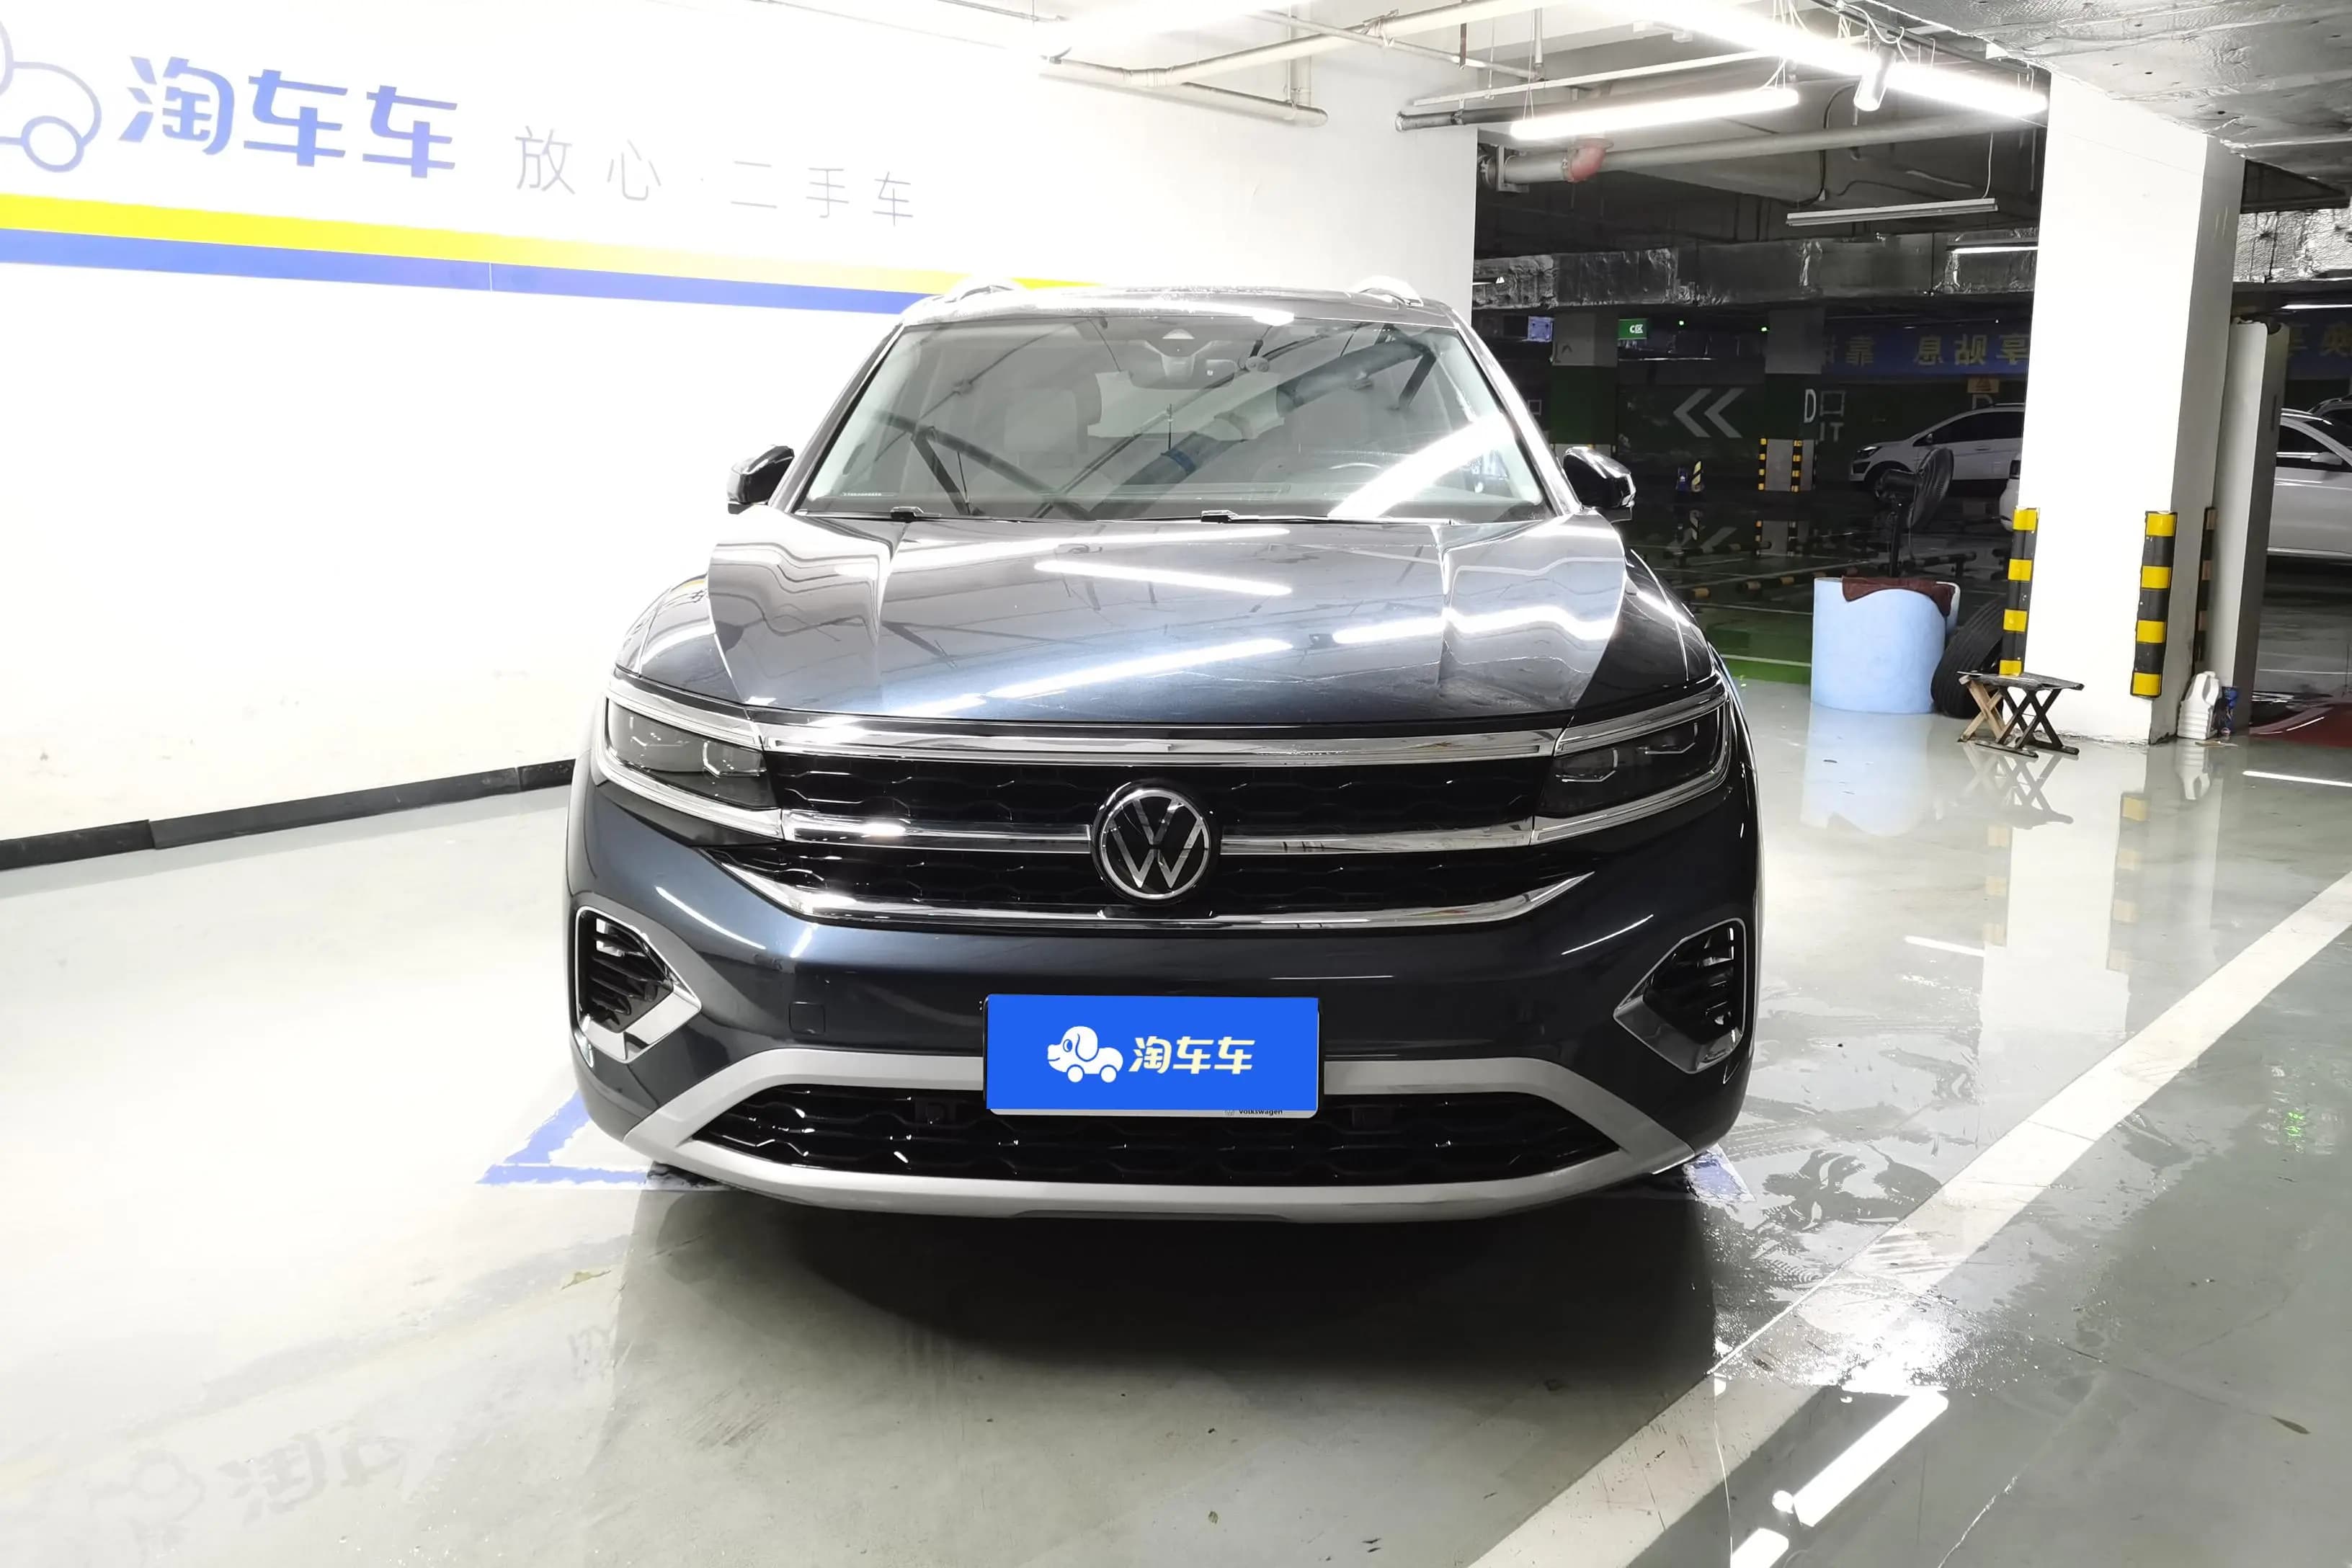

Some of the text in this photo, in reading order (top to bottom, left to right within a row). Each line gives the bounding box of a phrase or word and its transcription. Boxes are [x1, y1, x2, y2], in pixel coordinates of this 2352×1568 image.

[119, 55, 458, 179] 淘车车
[1819, 391, 1845, 417] 口
[1819, 421, 1845, 442] IT
